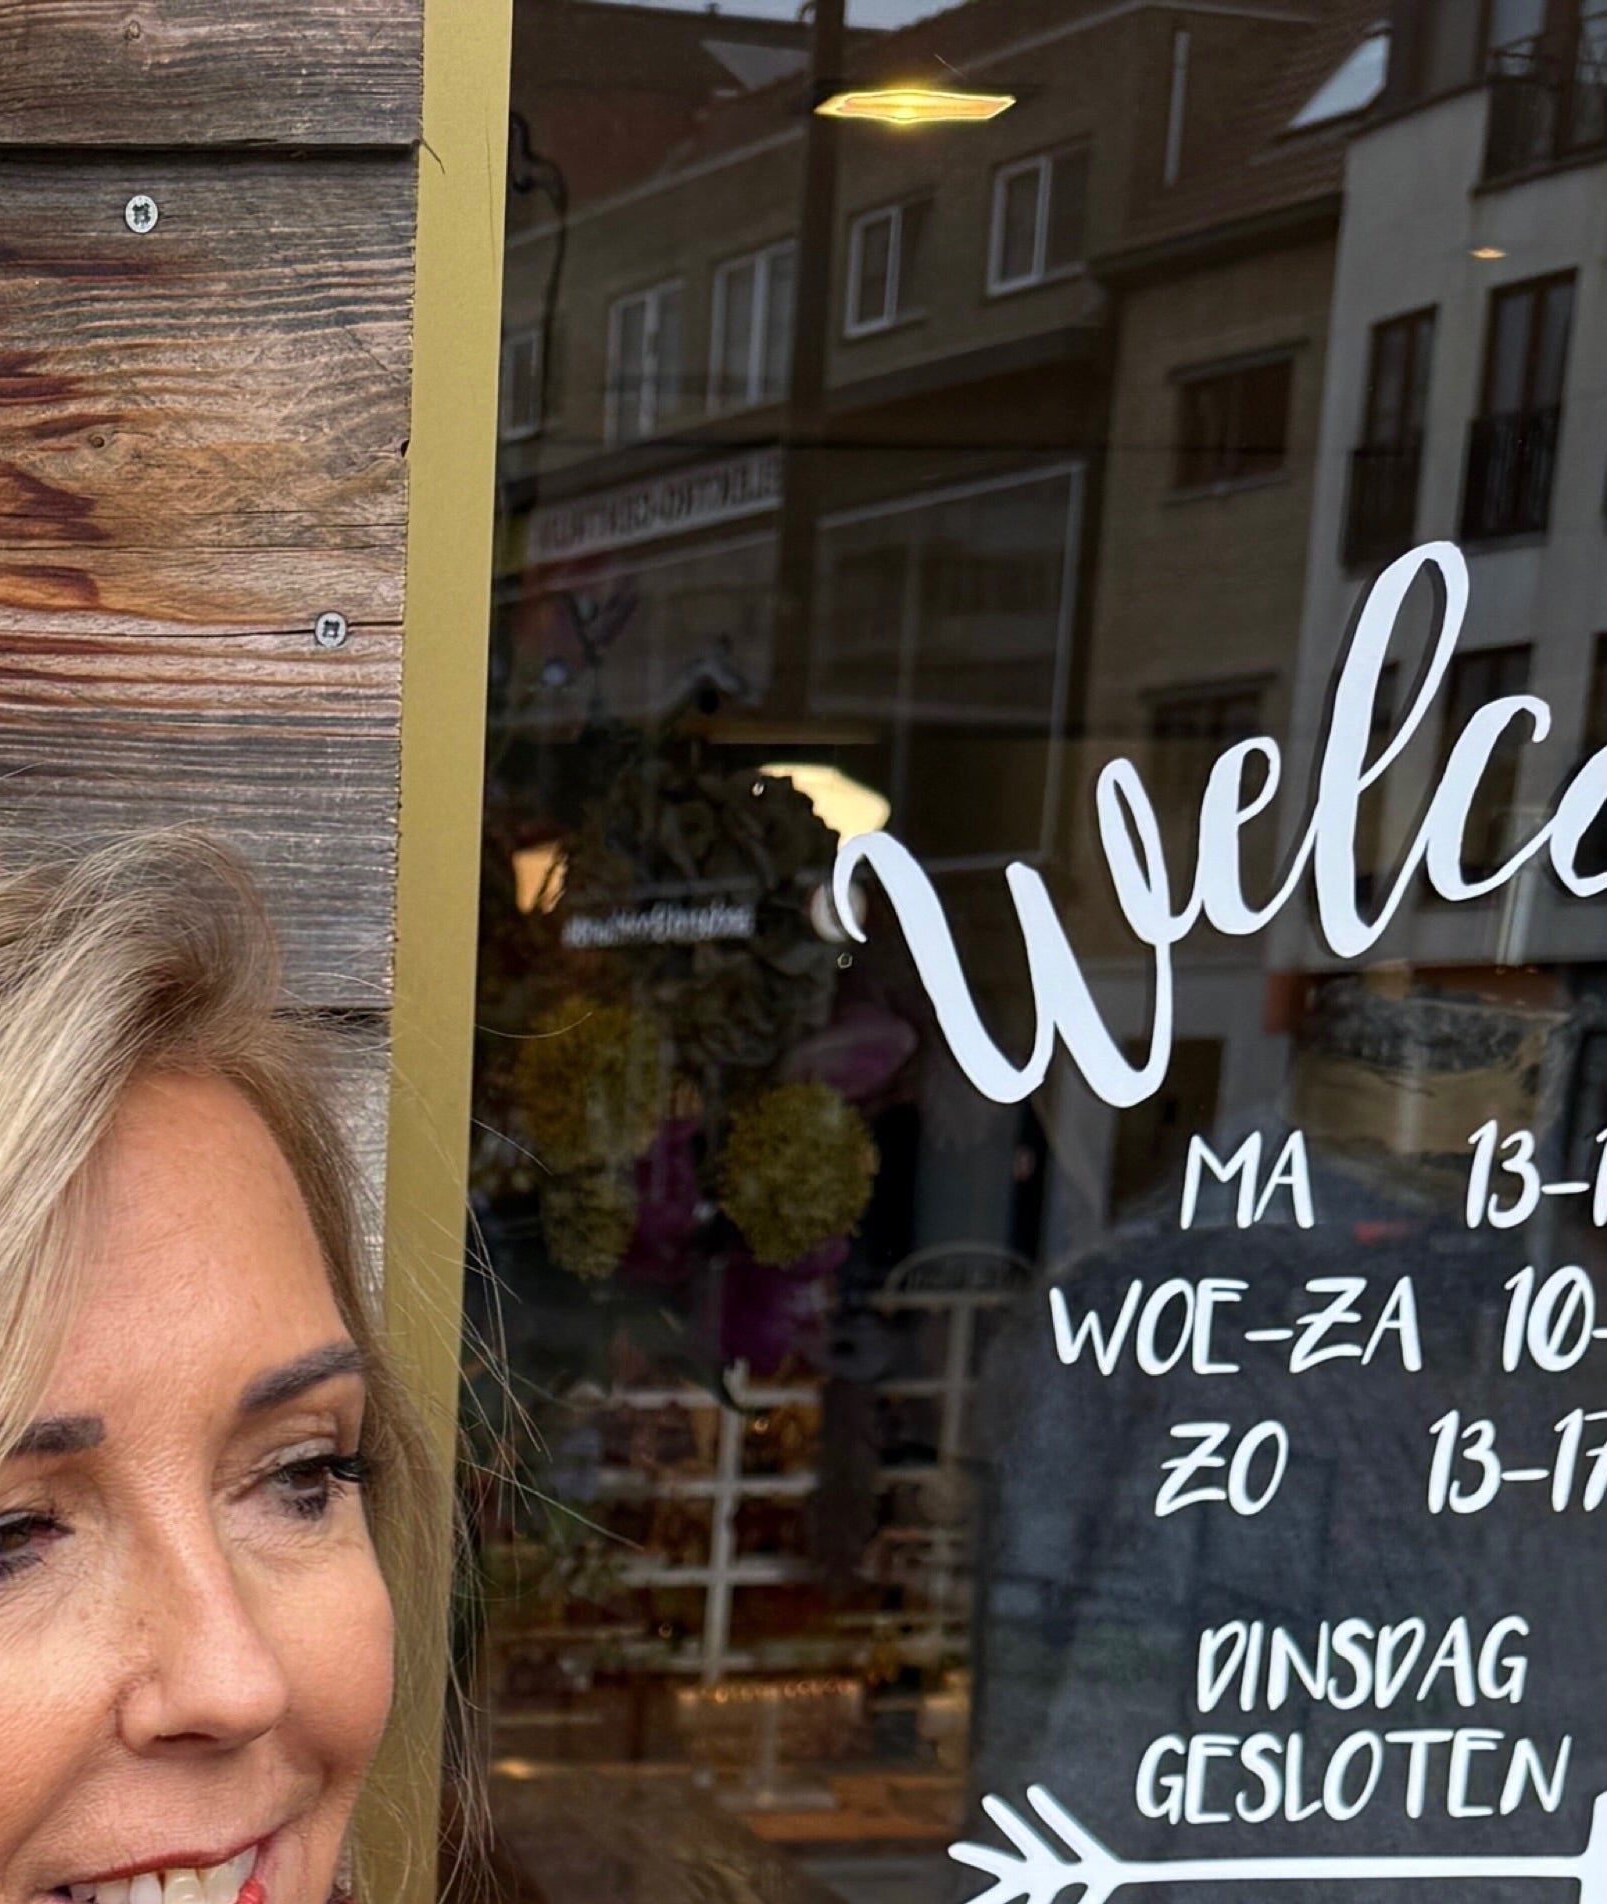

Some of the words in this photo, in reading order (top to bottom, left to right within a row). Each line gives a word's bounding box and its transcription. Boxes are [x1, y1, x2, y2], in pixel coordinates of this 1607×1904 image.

[1181, 1131, 1314, 1229] MA
[1050, 1277, 1421, 1375] WOE-ZA
[1155, 1421, 1287, 1516] ZO
[1198, 1616, 1528, 1712] DINSDAG
[1137, 1729, 1570, 1824] GESLOTEN
